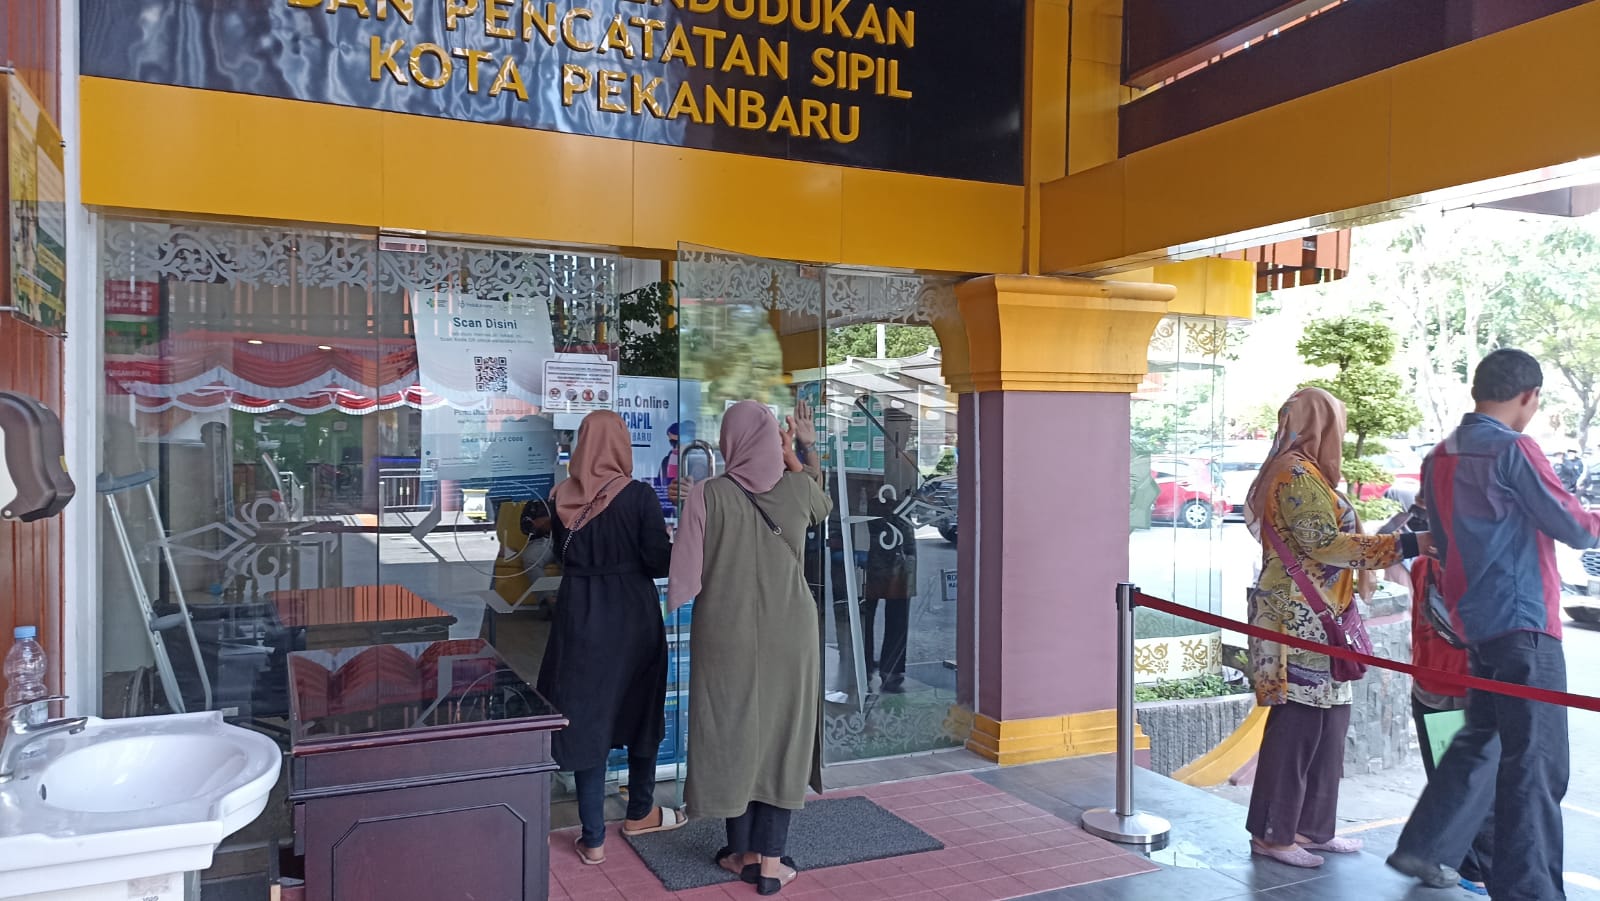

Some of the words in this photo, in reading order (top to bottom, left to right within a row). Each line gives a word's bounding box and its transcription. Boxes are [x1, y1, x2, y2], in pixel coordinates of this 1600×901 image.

[622, 0, 914, 48] UDUKAN
[287, 0, 414, 25] AN
[446, 0, 788, 80] PENCATATAN
[810, 47, 912, 99] SIPIL
[370, 35, 528, 101] KOTA
[562, 63, 860, 143] PEKANBARU
[453, 317, 482, 328] Scan
[485, 318, 517, 329] Disini
[617, 398, 631, 407] an
[634, 395, 669, 409] Online
[620, 411, 652, 429] CAPIL
[632, 431, 652, 442] BARU
